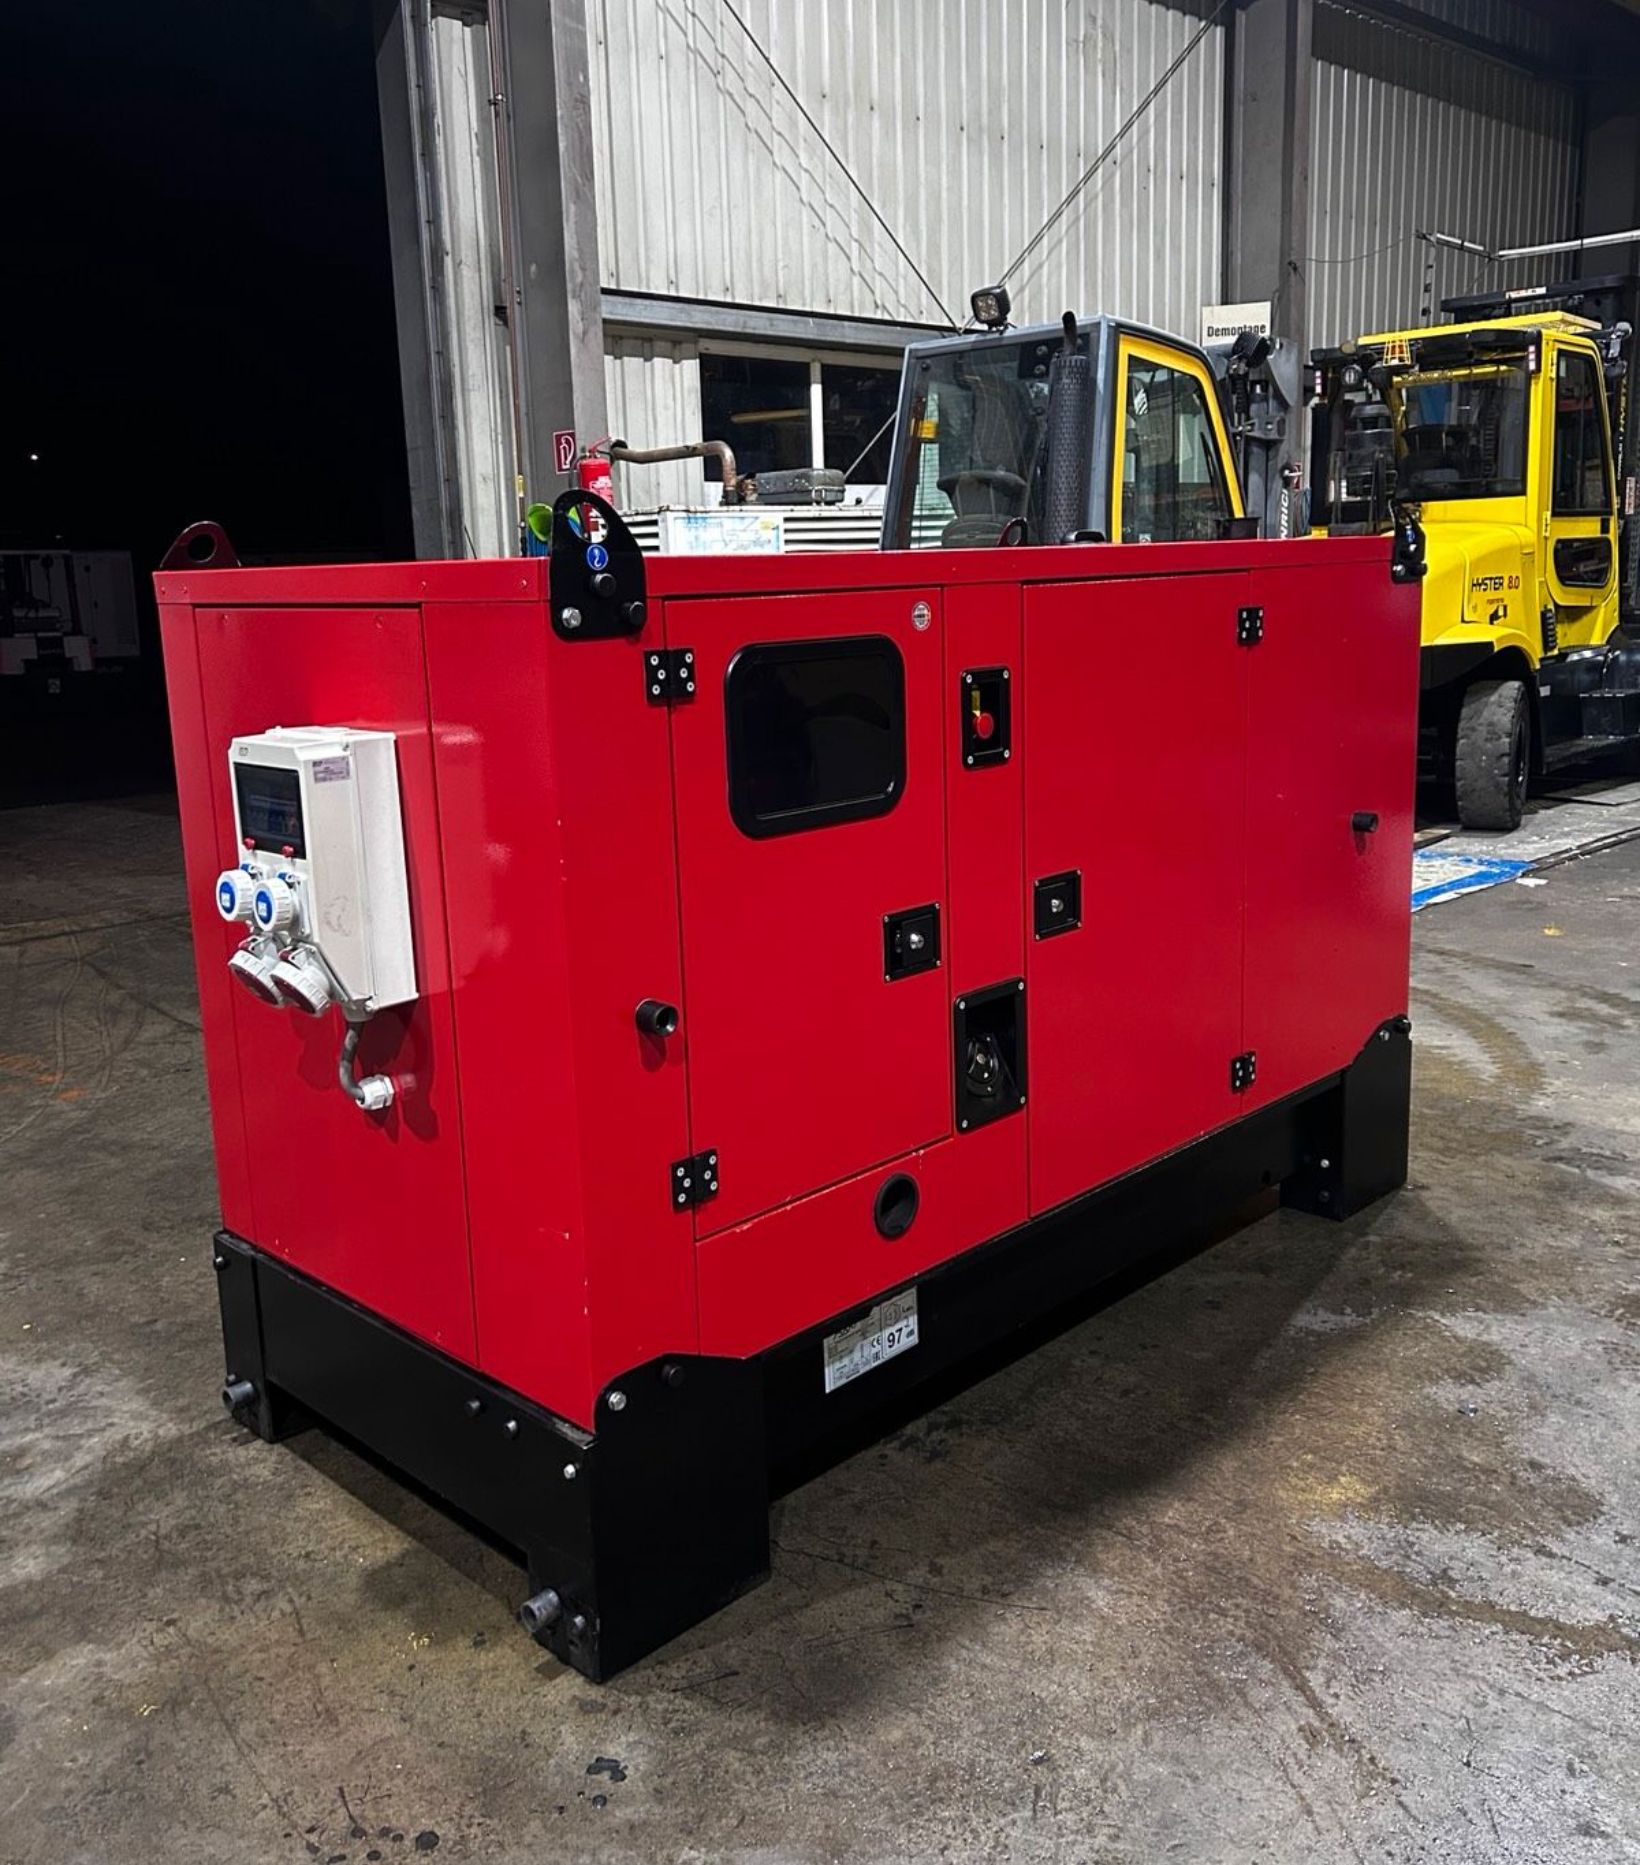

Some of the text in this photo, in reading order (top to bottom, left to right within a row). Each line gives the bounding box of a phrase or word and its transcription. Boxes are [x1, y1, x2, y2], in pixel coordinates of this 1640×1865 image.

[1207, 324, 1267, 337] Demontage
[1471, 576, 1504, 593] HYSTER
[871, 1335, 881, 1349] CE
[887, 1327, 903, 1349] 97
